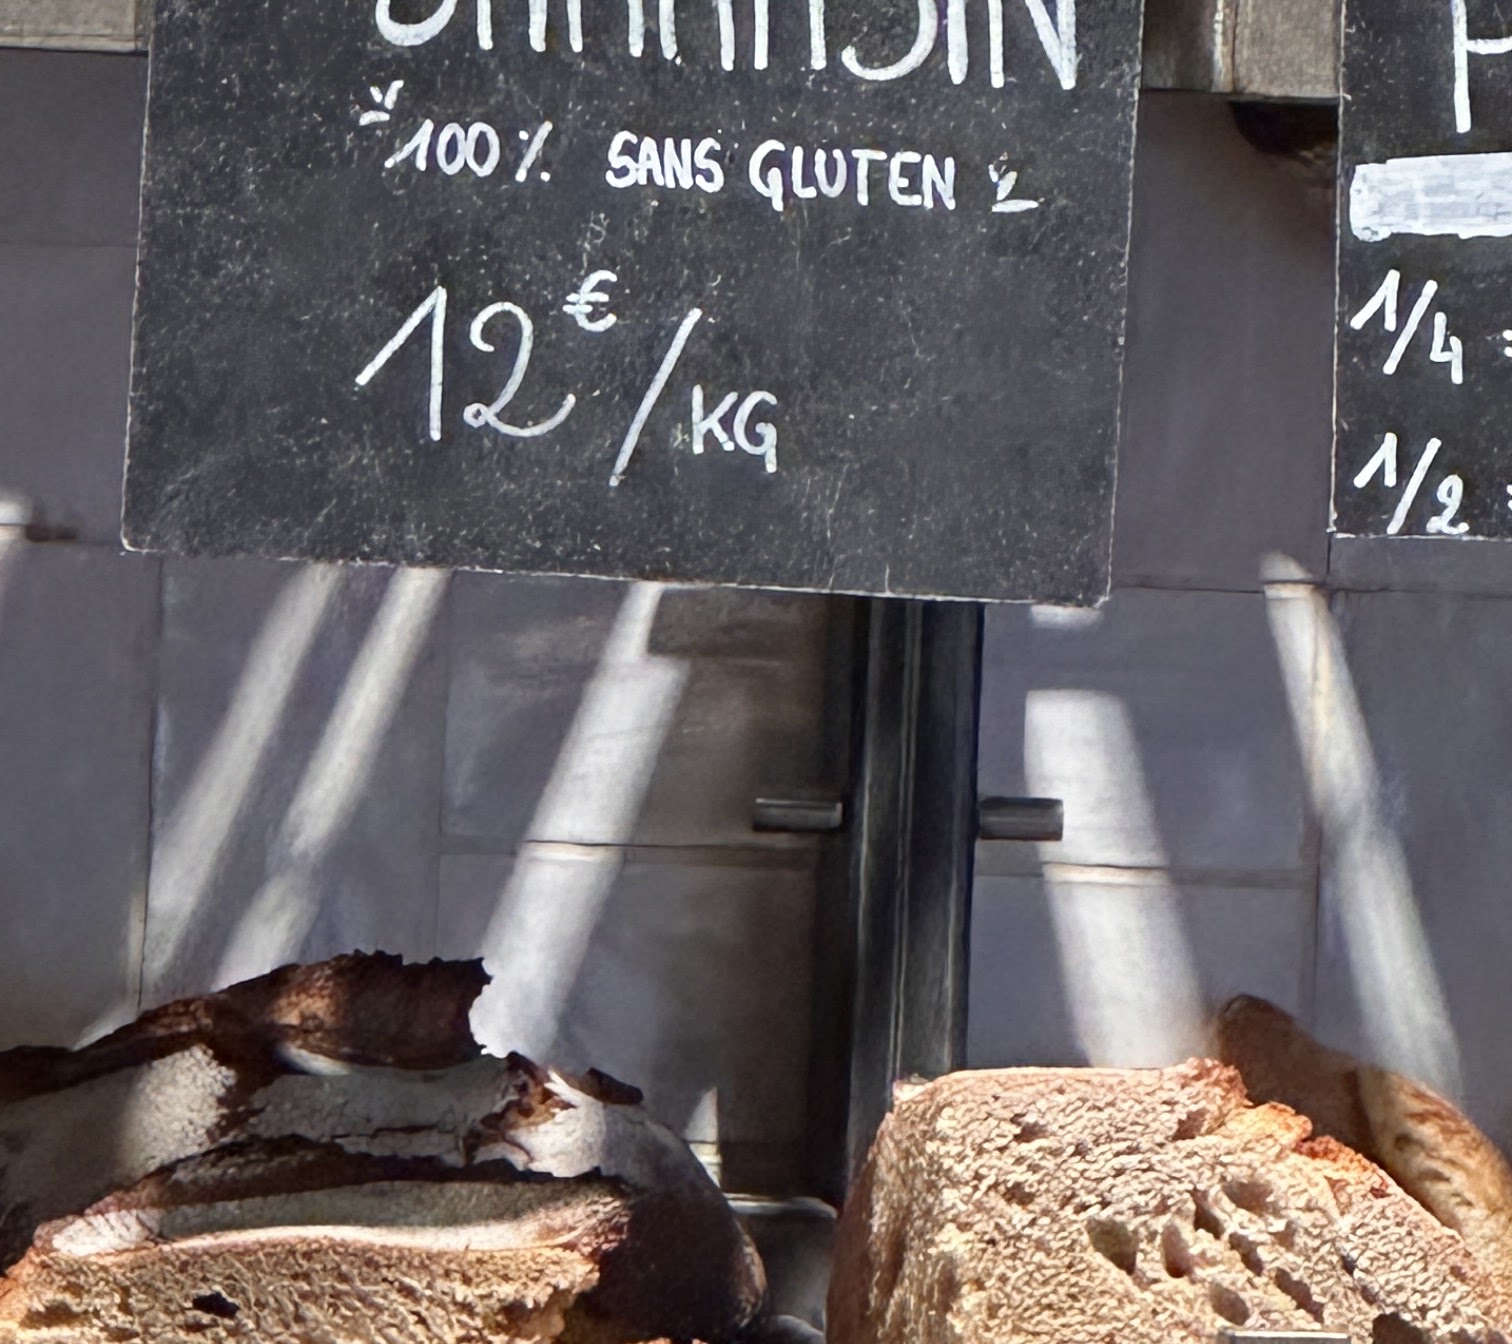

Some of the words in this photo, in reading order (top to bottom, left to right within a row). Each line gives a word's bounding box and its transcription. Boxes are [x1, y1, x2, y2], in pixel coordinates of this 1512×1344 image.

[605, 129, 726, 194] SANS
[747, 138, 958, 212] GLUTEN
[1348, 269, 1465, 386] 1/4
[1352, 432, 1471, 539] 1/2
